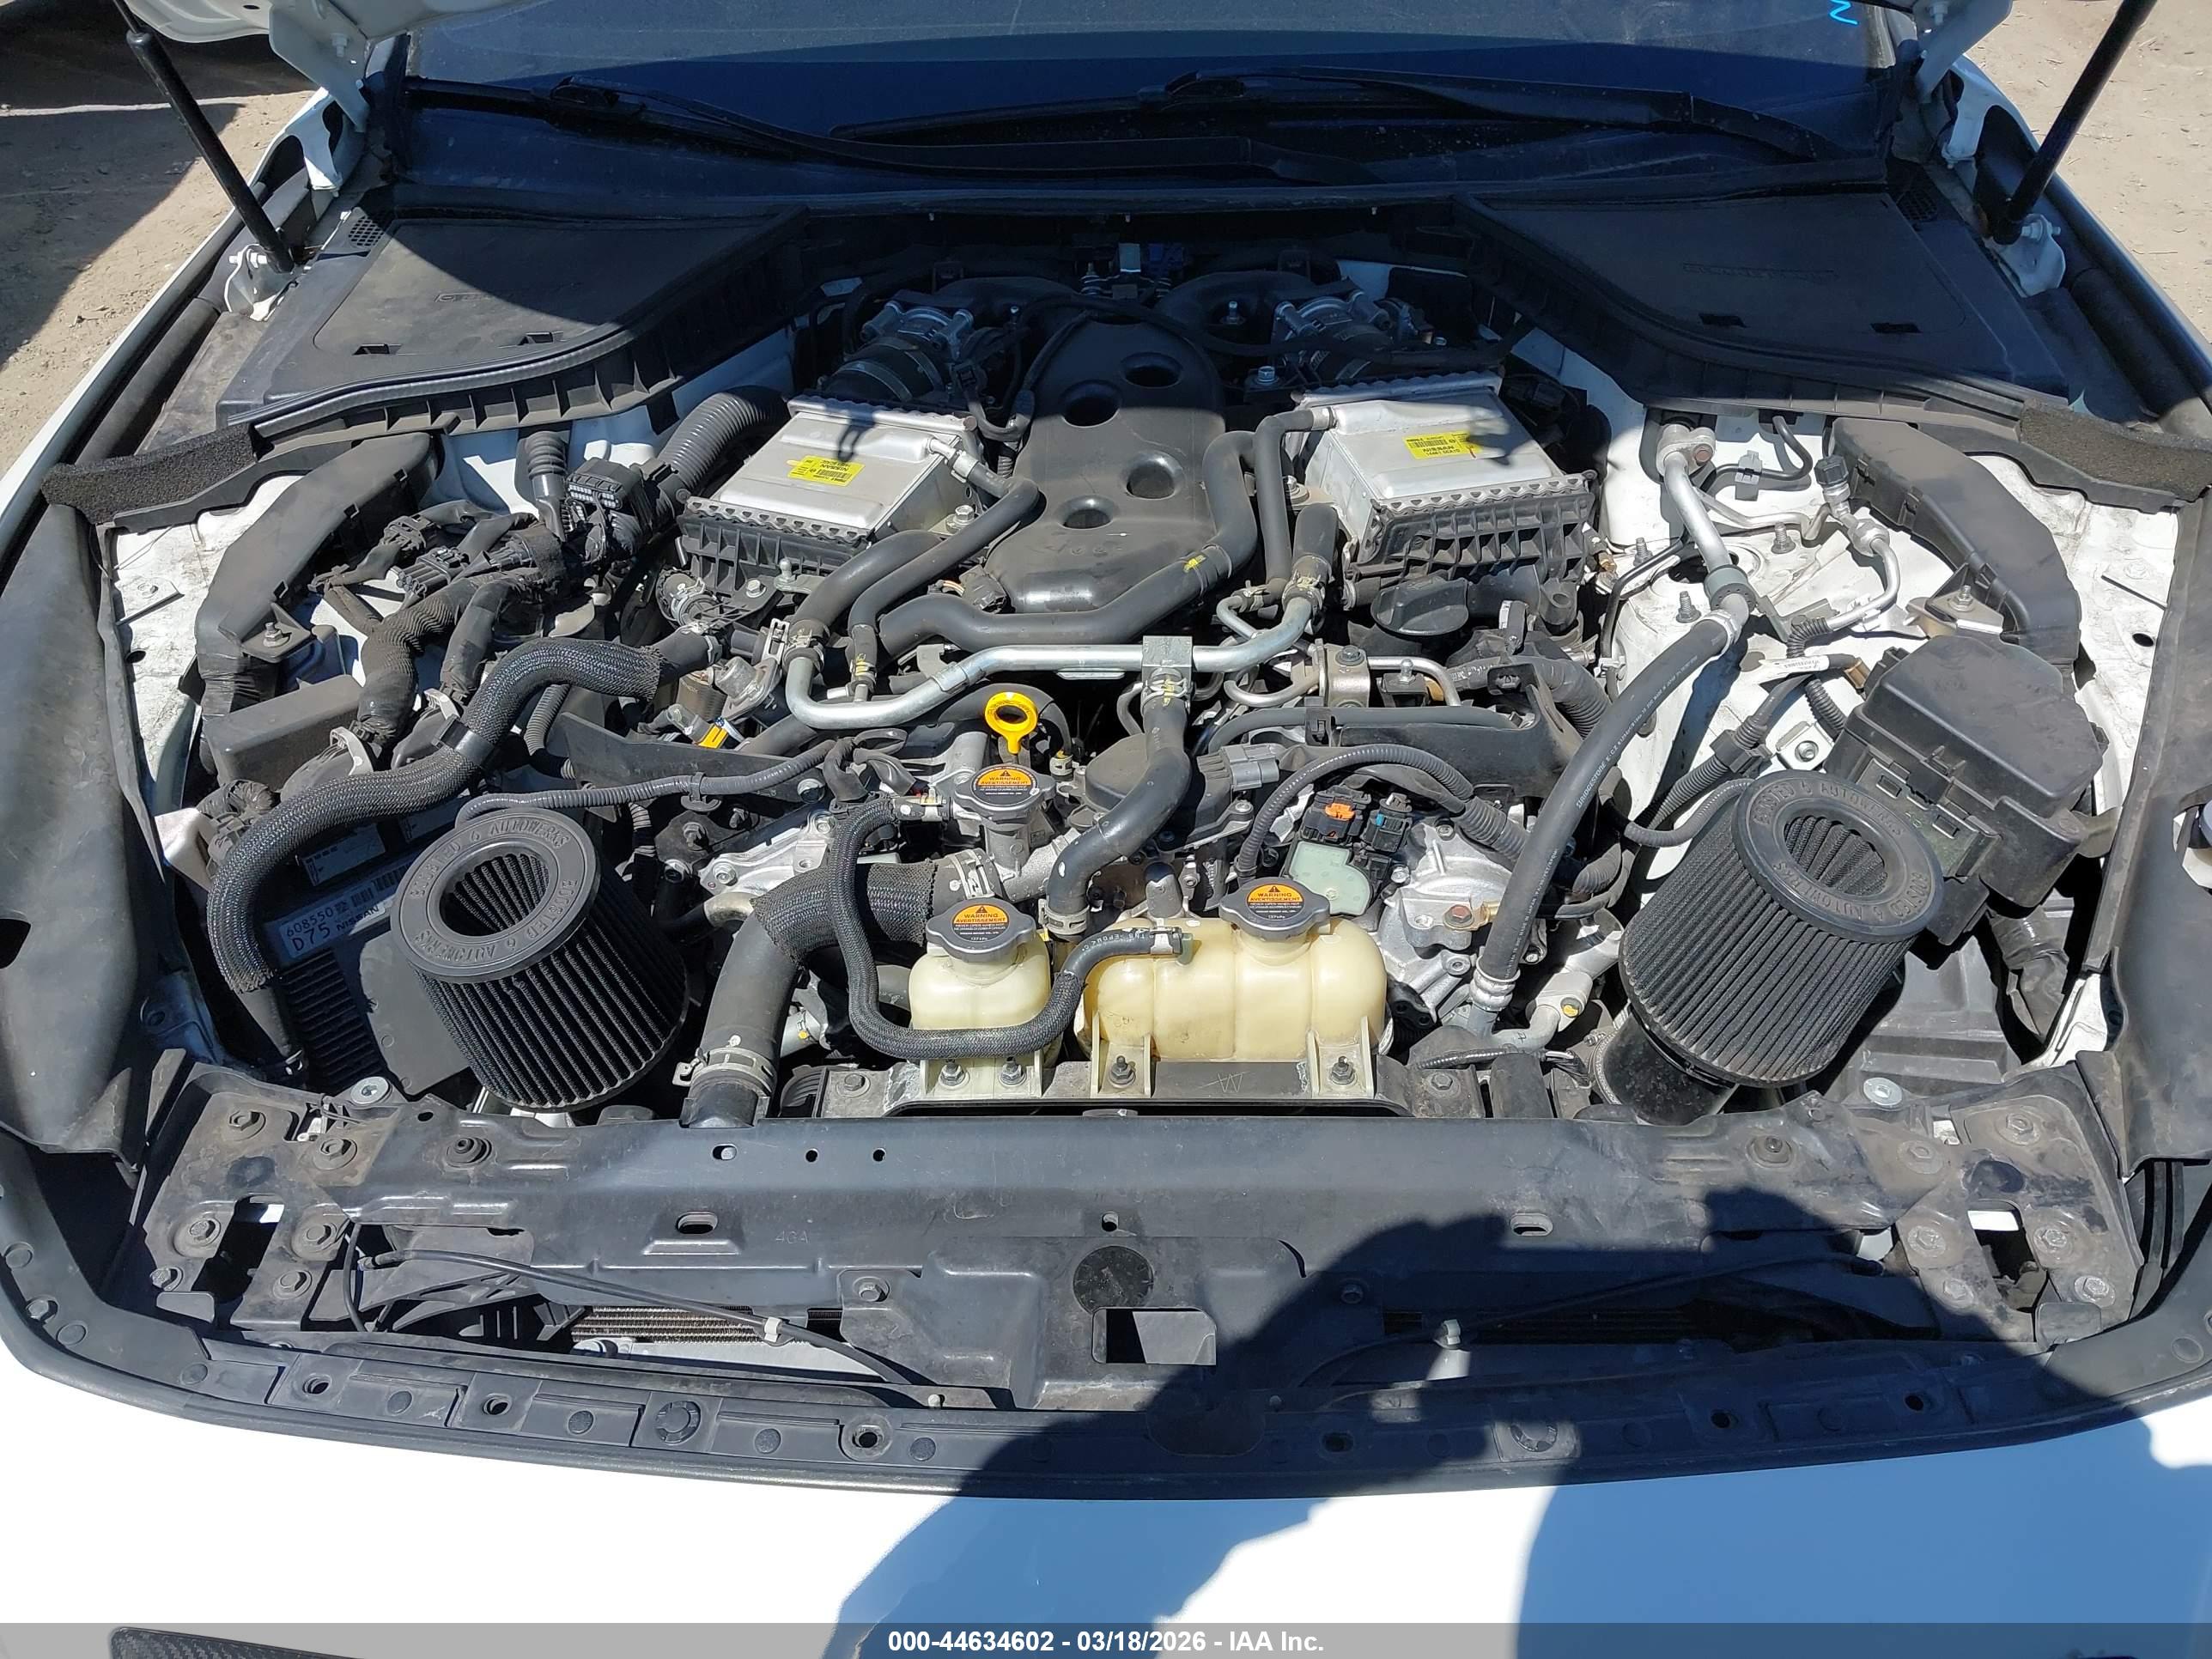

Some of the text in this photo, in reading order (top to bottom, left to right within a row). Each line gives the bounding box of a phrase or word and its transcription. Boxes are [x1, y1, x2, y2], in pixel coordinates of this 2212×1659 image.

[1576, 761, 1607, 809] BRIDGESTONE
[489, 817, 570, 849] AUTOWERKS
[287, 906, 334, 939] 608550
[336, 904, 380, 932] NISSAN
